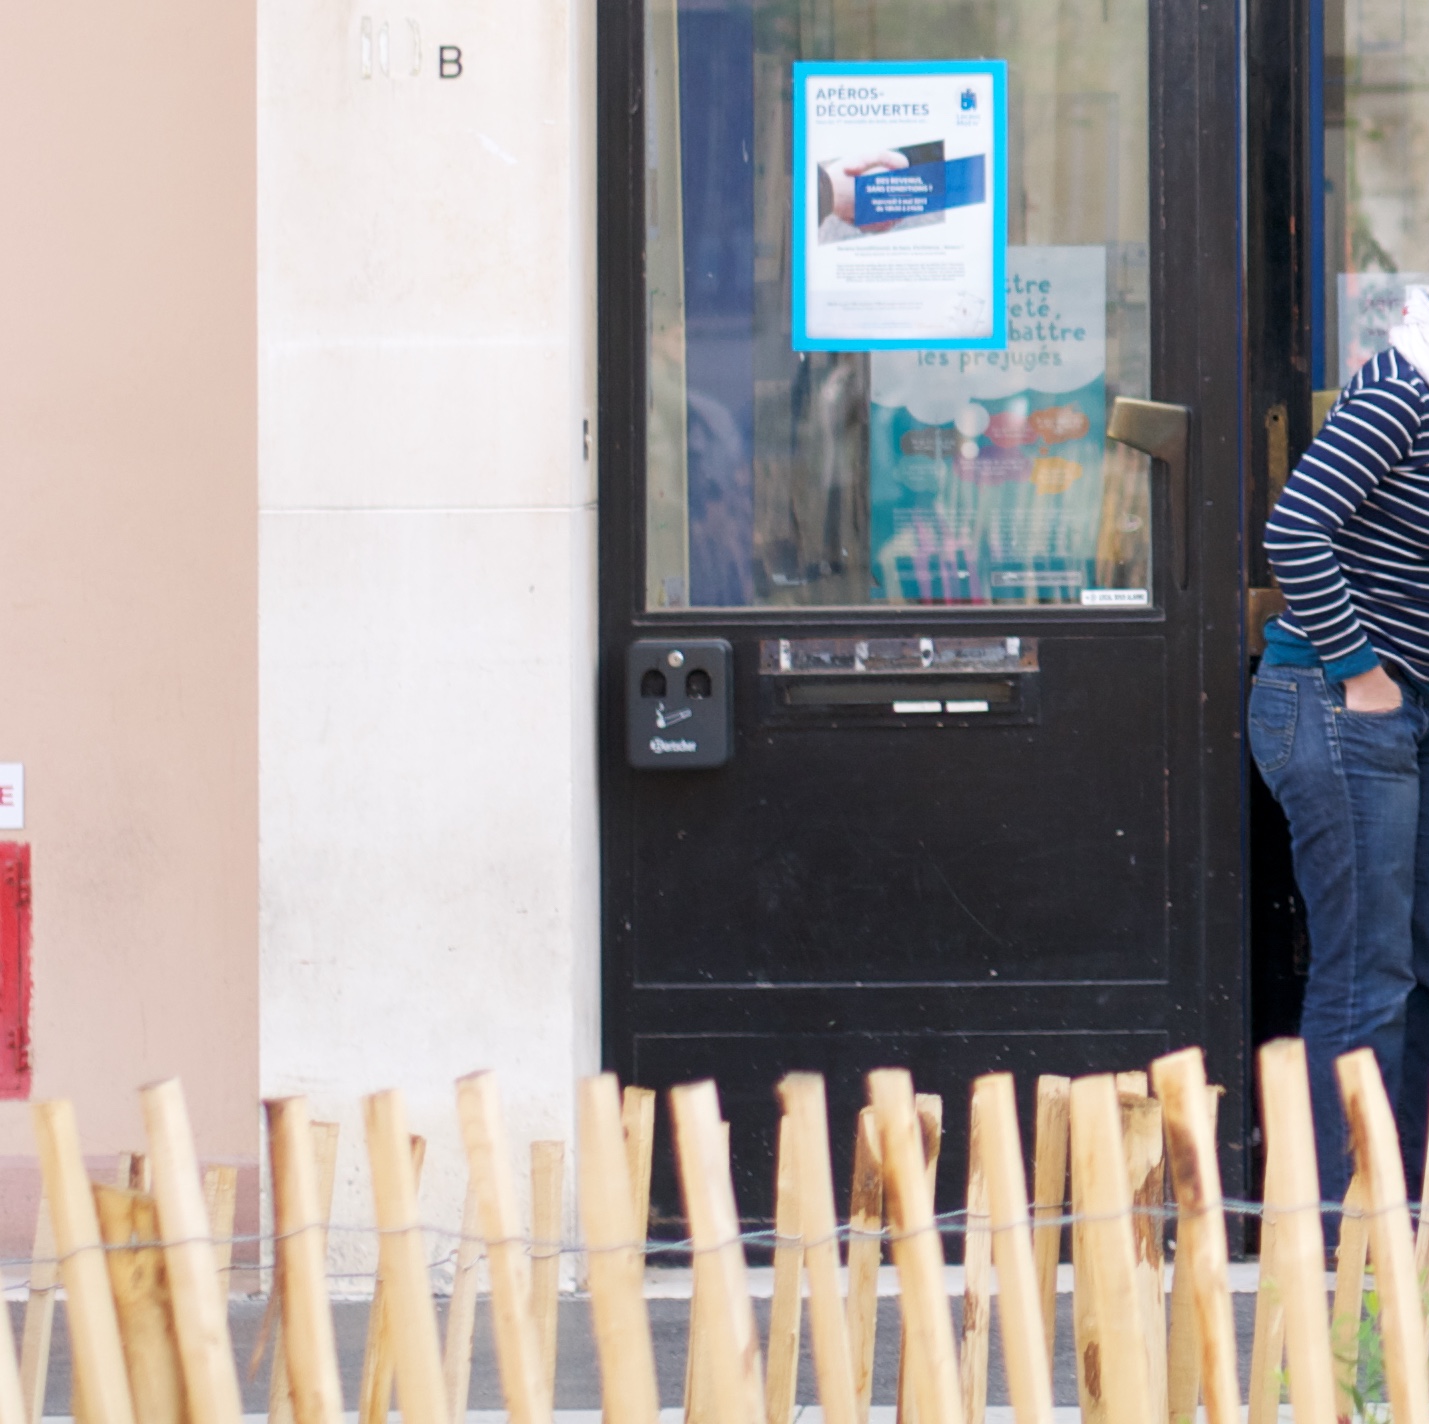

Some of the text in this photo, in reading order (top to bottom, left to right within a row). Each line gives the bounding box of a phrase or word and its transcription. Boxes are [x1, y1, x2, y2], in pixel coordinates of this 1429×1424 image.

[438, 44, 464, 79] B
[816, 85, 885, 101] APÉROS-
[816, 101, 930, 117] DÉCOUVERTES
